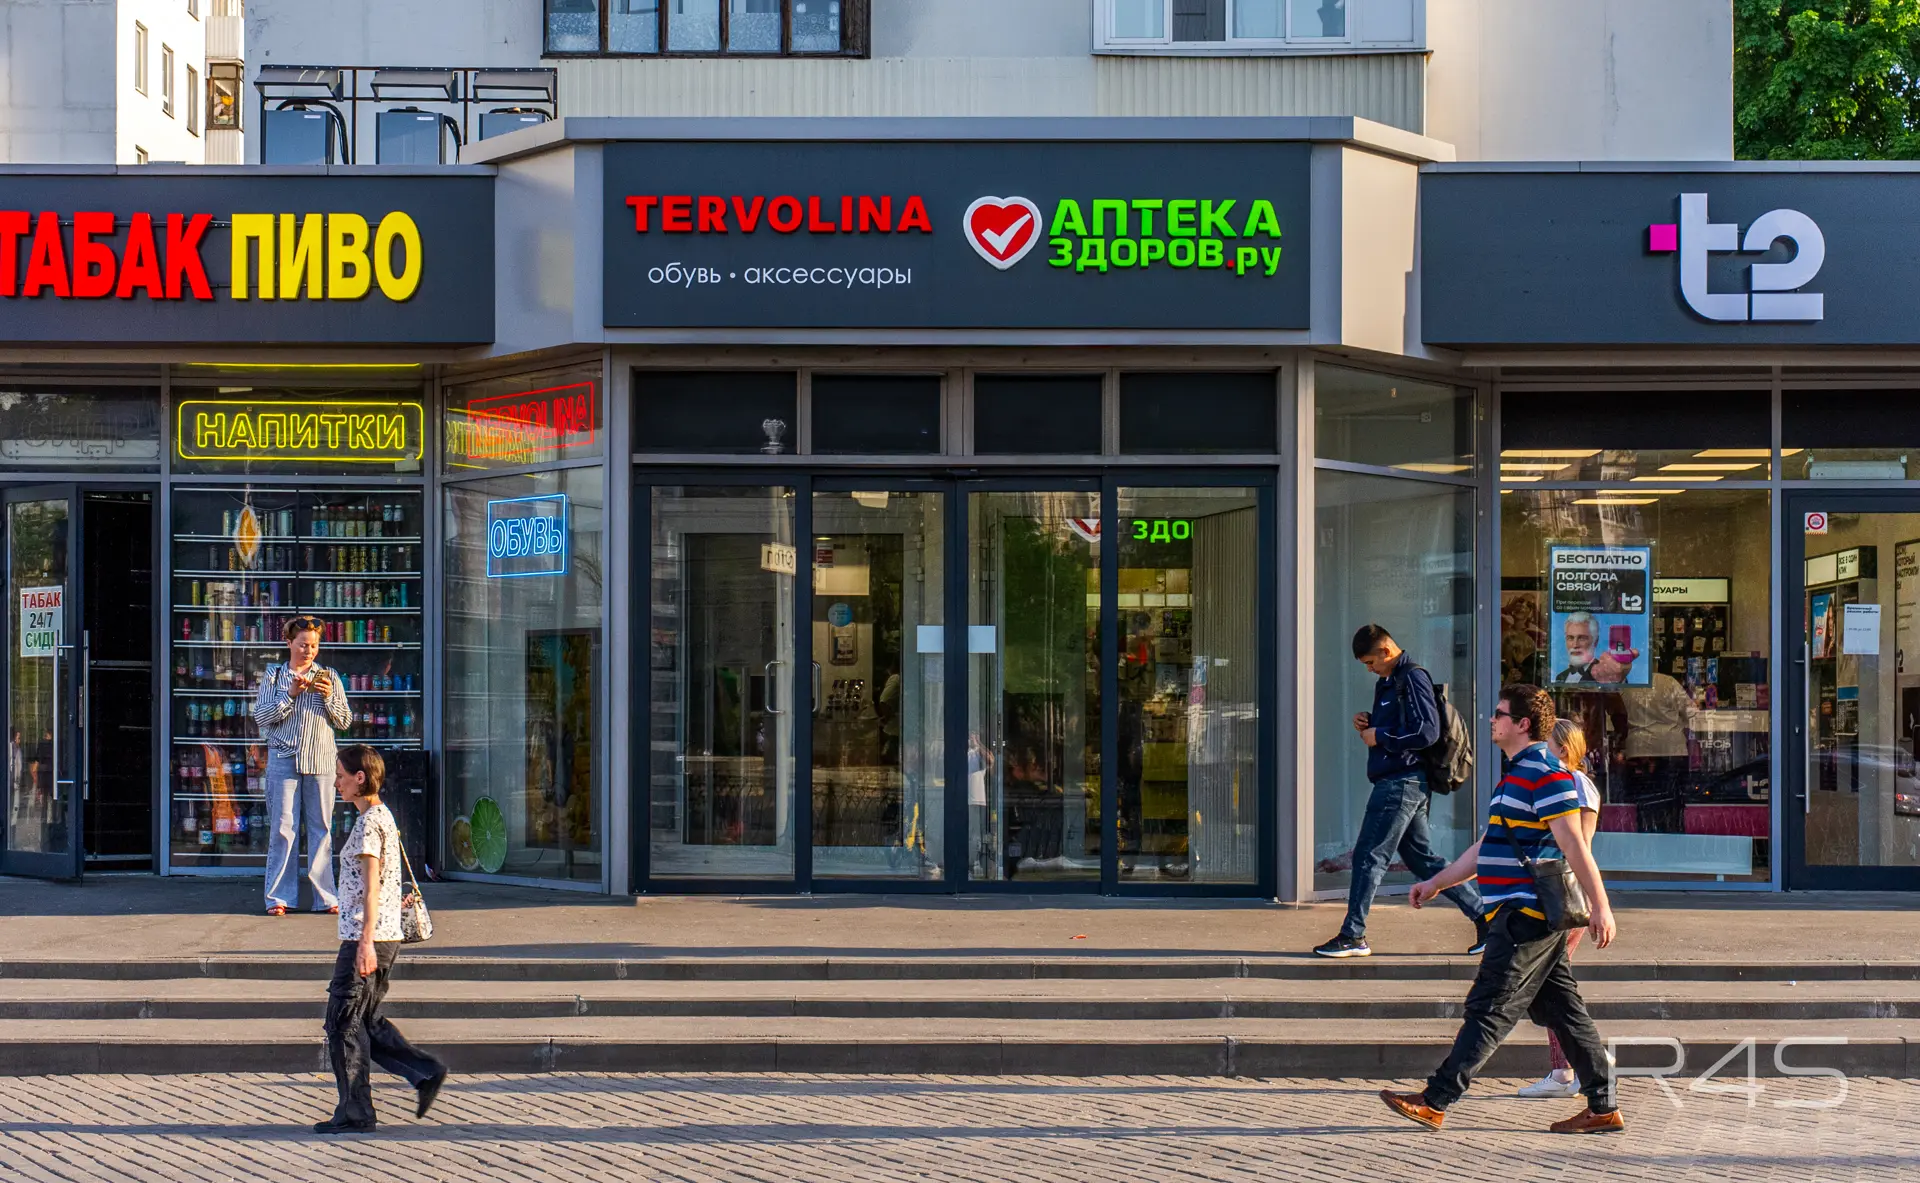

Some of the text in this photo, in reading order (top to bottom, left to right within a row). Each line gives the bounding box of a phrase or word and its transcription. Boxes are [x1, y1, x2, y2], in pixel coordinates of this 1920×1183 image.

[626, 195, 932, 232] TERVOLINA
[1049, 199, 1282, 237] АПТЕКА
[0, 210, 422, 301] ТАБАК ПИВО
[1049, 238, 1282, 276] ЗДОРОВ.ру
[1679, 192, 1826, 321] t2
[647, 261, 912, 289] обувь аксессуары
[196, 413, 406, 450] НАПИТКИ
[490, 515, 562, 558] ОБУВЬ
[1132, 520, 1193, 543] ЗДО
[1557, 554, 1642, 565] БЕСПЛАТНО
[1556, 572, 1618, 582] ПОЛГОДА
[1556, 582, 1601, 592] СВЯЗИ
[22, 591, 62, 609] ТАБАК
[1621, 592, 1642, 611] t2
[29, 611, 54, 629] 24/7
[25, 631, 55, 650] СИД
